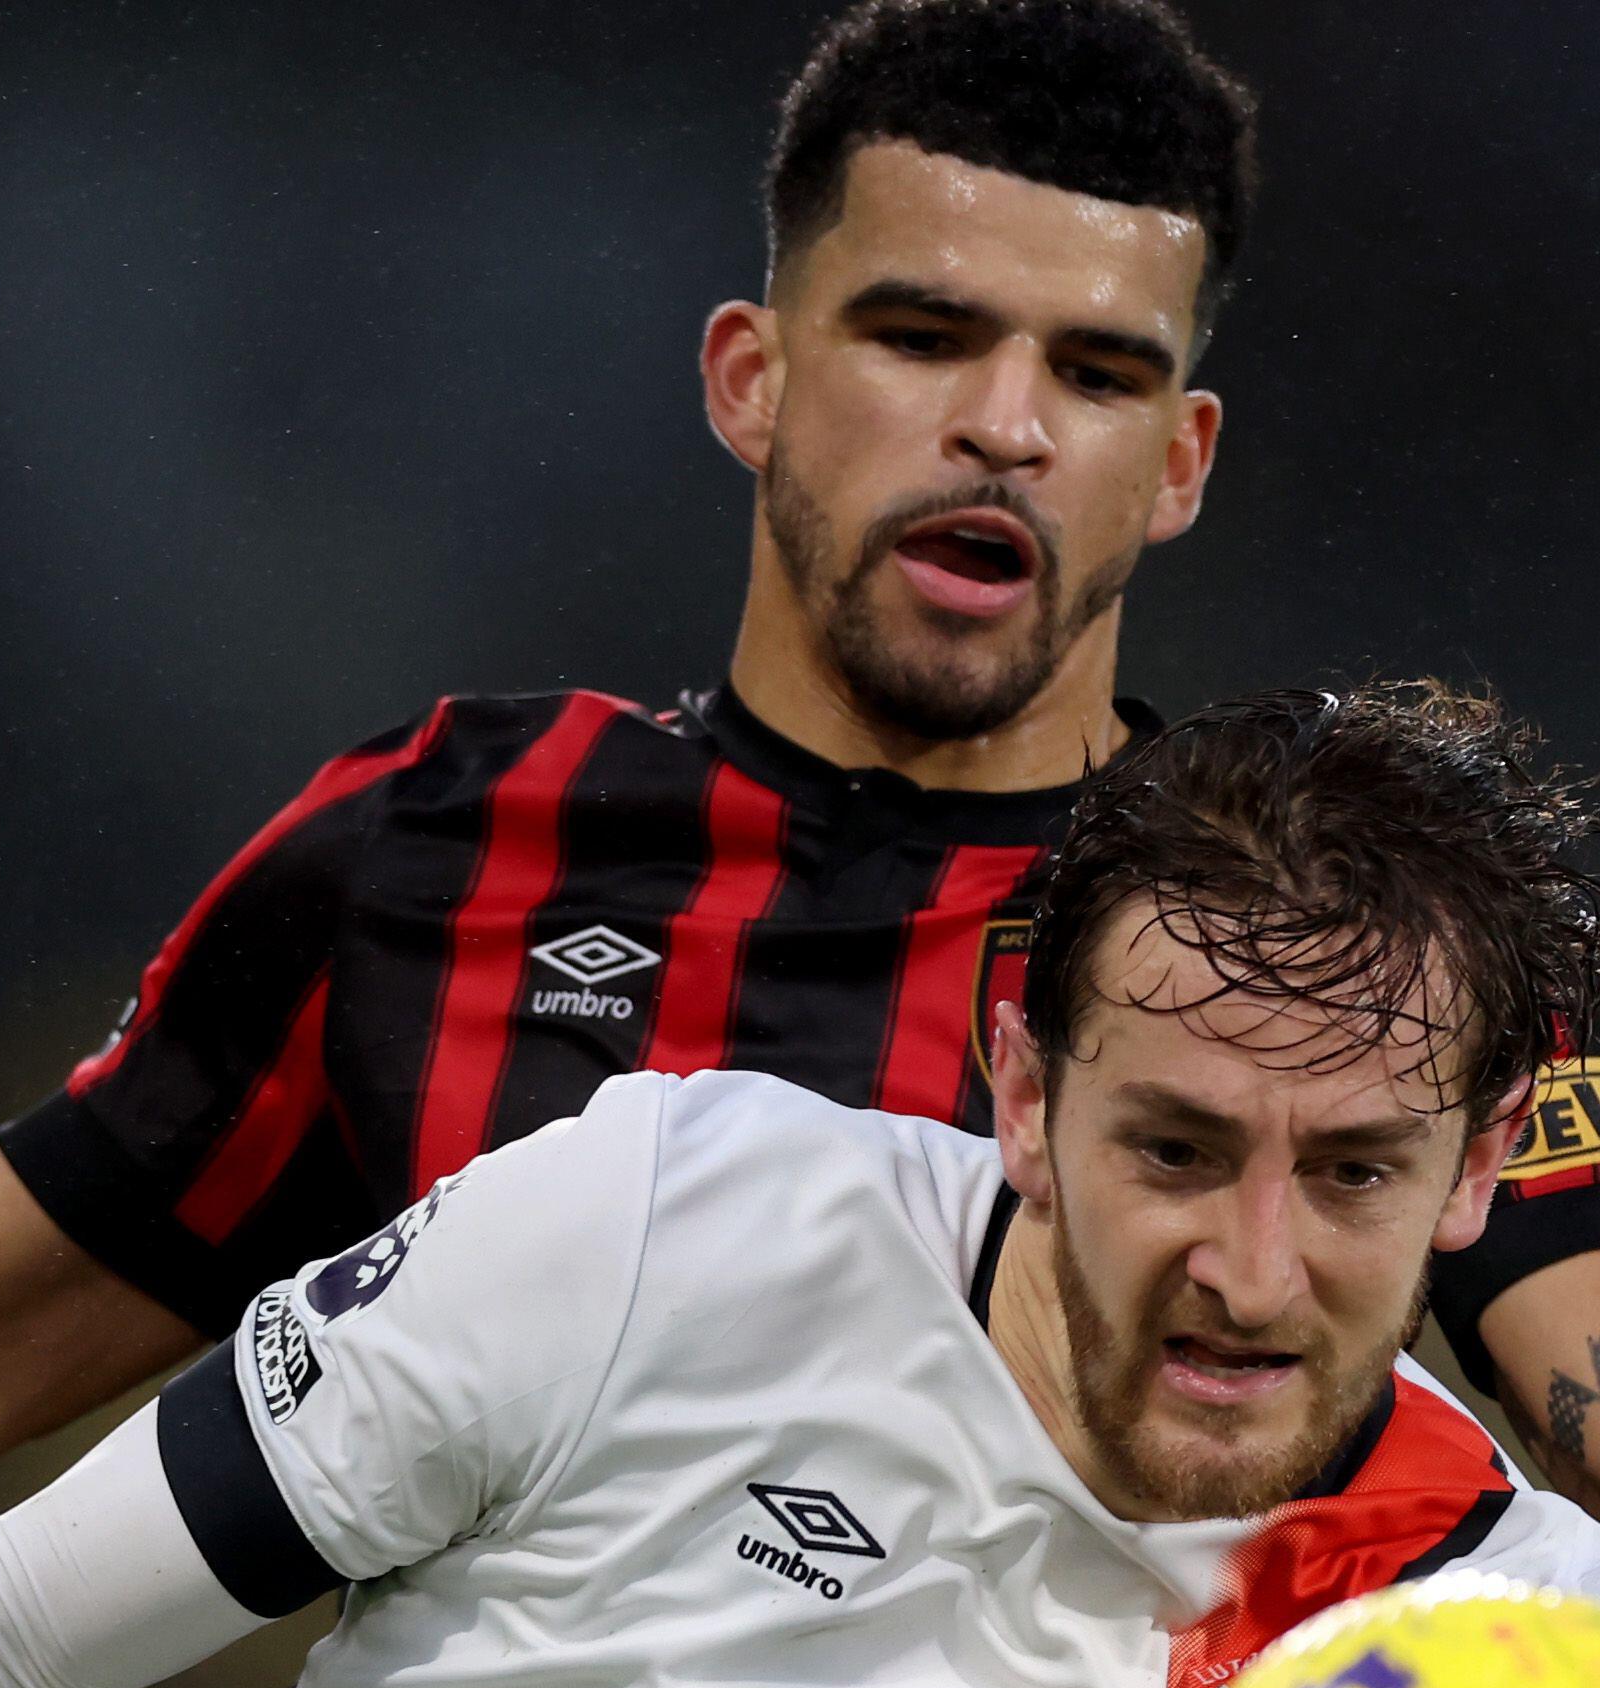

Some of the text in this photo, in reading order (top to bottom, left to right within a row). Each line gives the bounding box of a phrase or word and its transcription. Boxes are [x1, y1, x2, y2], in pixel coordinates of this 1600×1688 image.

[531, 987, 634, 1019] umbro
[256, 1318, 297, 1424] racism
[737, 1534, 843, 1600] umbro
